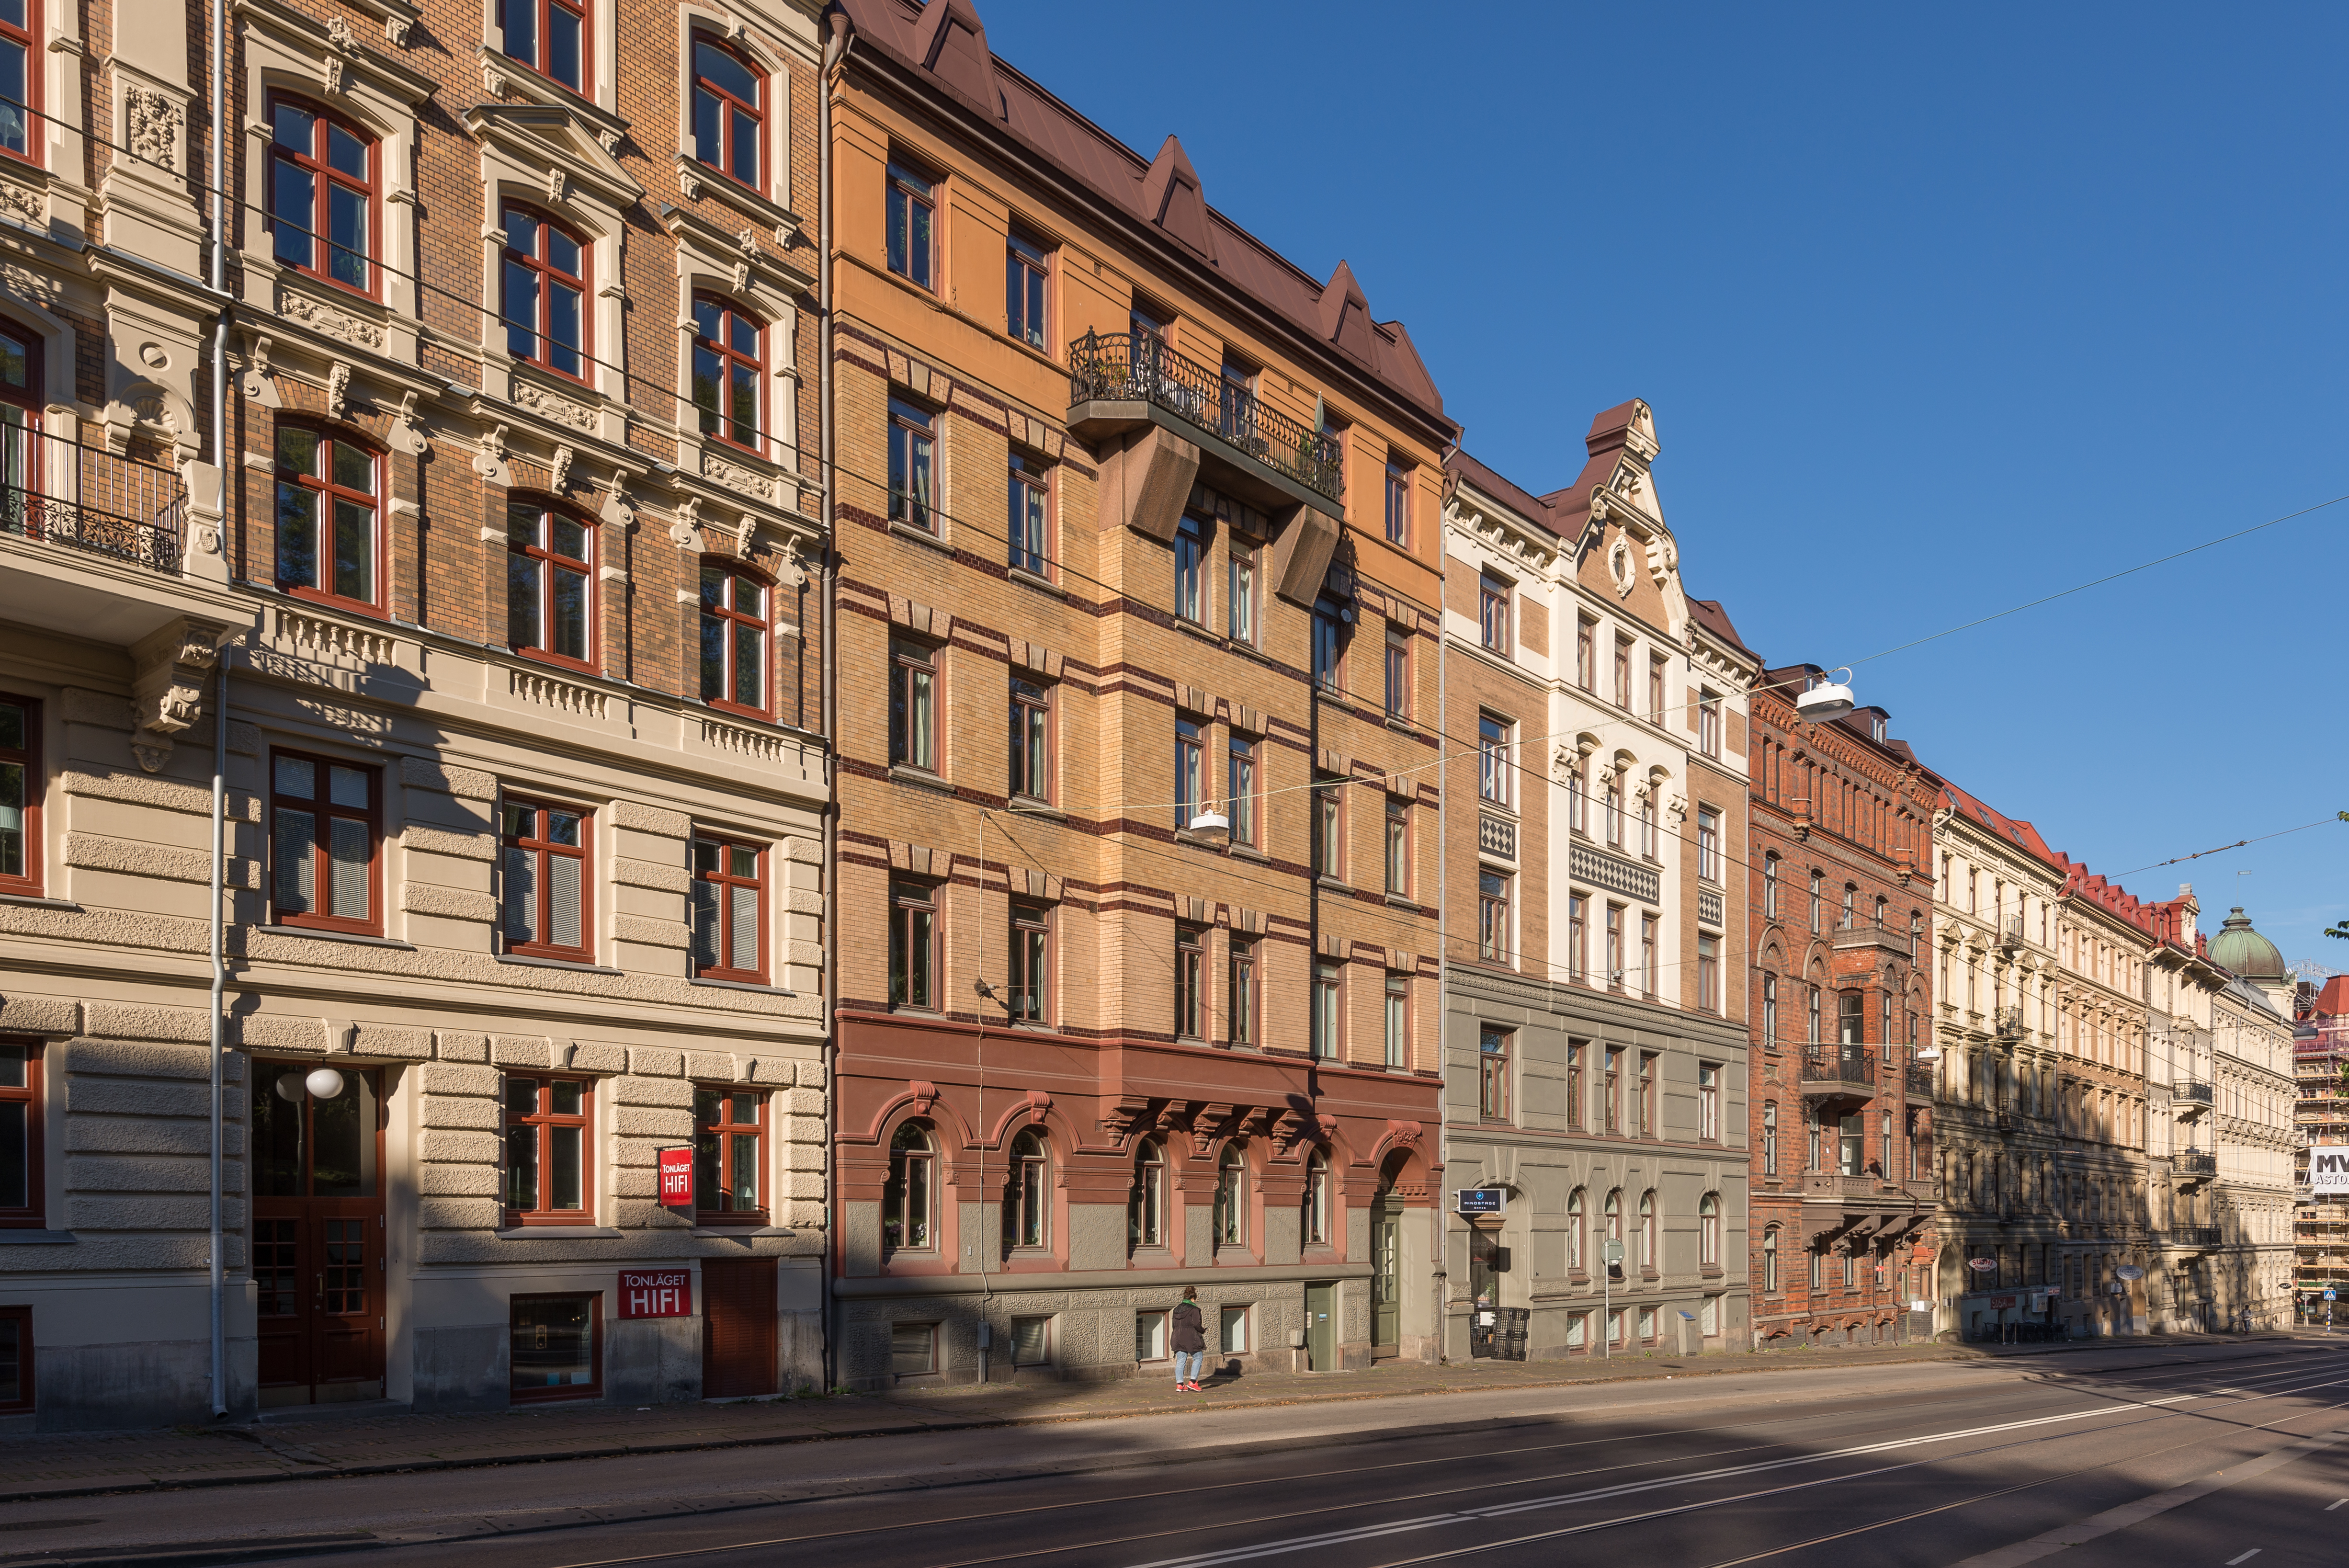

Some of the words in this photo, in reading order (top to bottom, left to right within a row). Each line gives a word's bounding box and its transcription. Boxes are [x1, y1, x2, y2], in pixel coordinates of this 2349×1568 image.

[662, 1163, 690, 1173] TONLÄGET
[665, 1175, 687, 1193] HIFI
[2315, 1174, 2349, 1184] ASTO
[624, 1273, 685, 1287] TONLÄGET
[631, 1289, 679, 1314] HIFI
